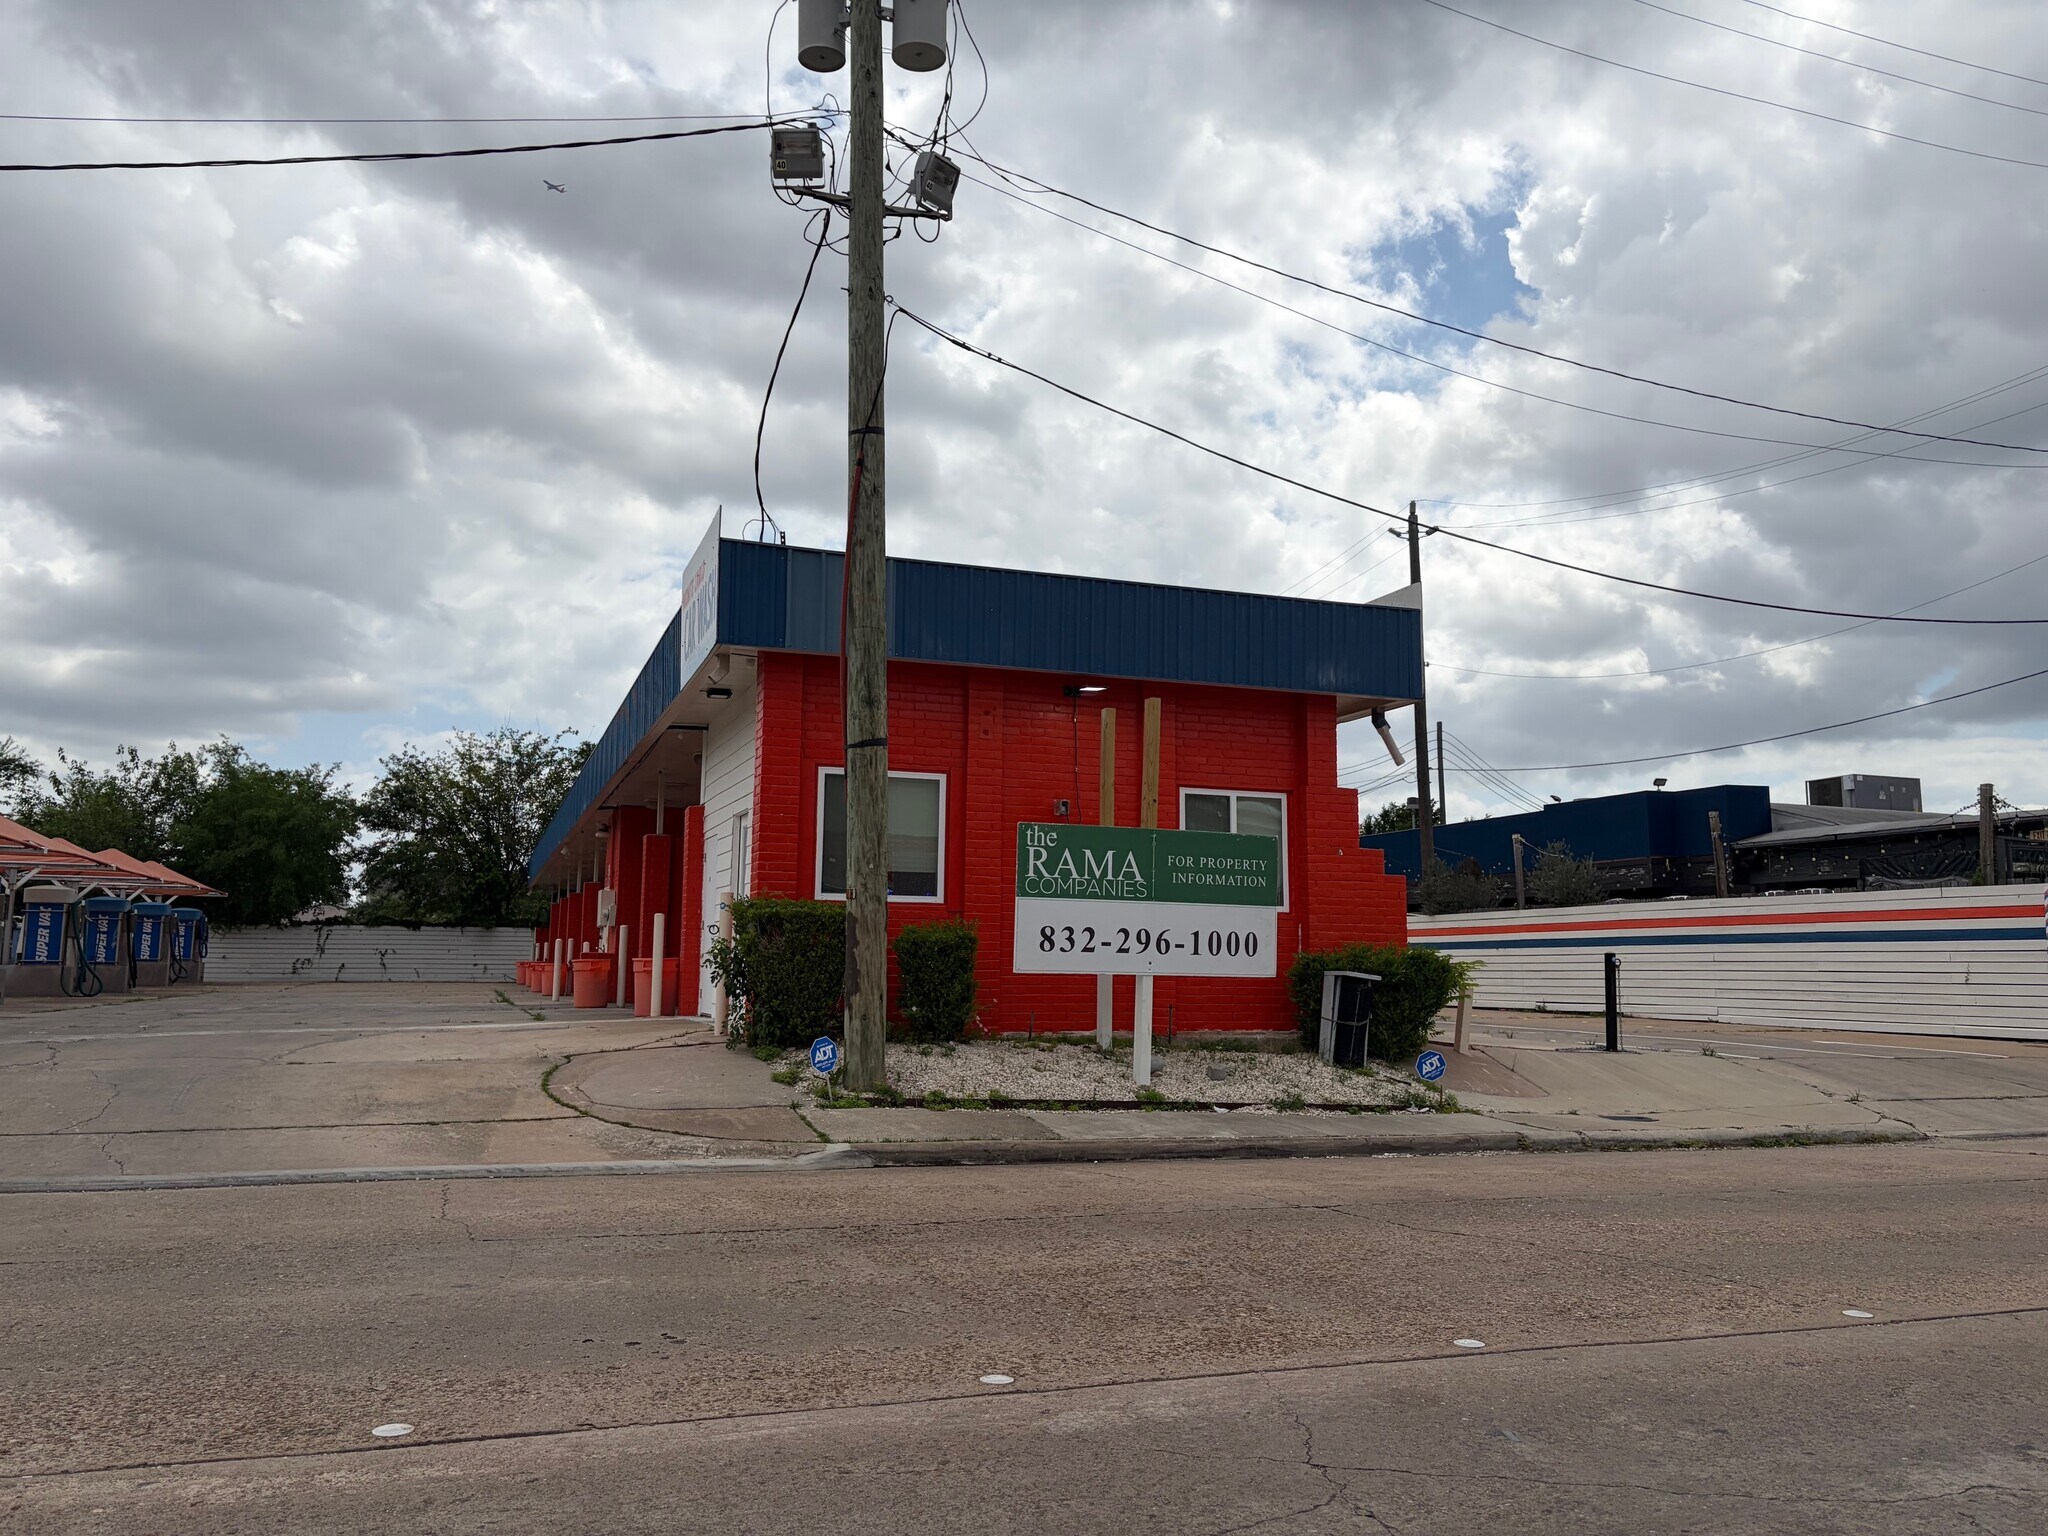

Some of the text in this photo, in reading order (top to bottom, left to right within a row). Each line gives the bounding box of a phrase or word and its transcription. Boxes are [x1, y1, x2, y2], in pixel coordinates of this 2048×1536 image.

[776, 160, 786, 170] 40
[926, 181, 934, 191] 40
[697, 564, 717, 644] WASH
[1026, 825, 1058, 847] the
[1025, 846, 1144, 882] RAMA
[1168, 855, 1268, 871] FOR PROPERTY
[1025, 877, 1148, 897] COMPANIES
[1172, 872, 1267, 887] INFORMATION
[35, 927, 50, 963] SUPER
[140, 933, 152, 960] SUPER
[1039, 926, 1258, 957] 832-296-1000
[814, 1044, 834, 1064] ADT
[1422, 1055, 1440, 1075] ADT
